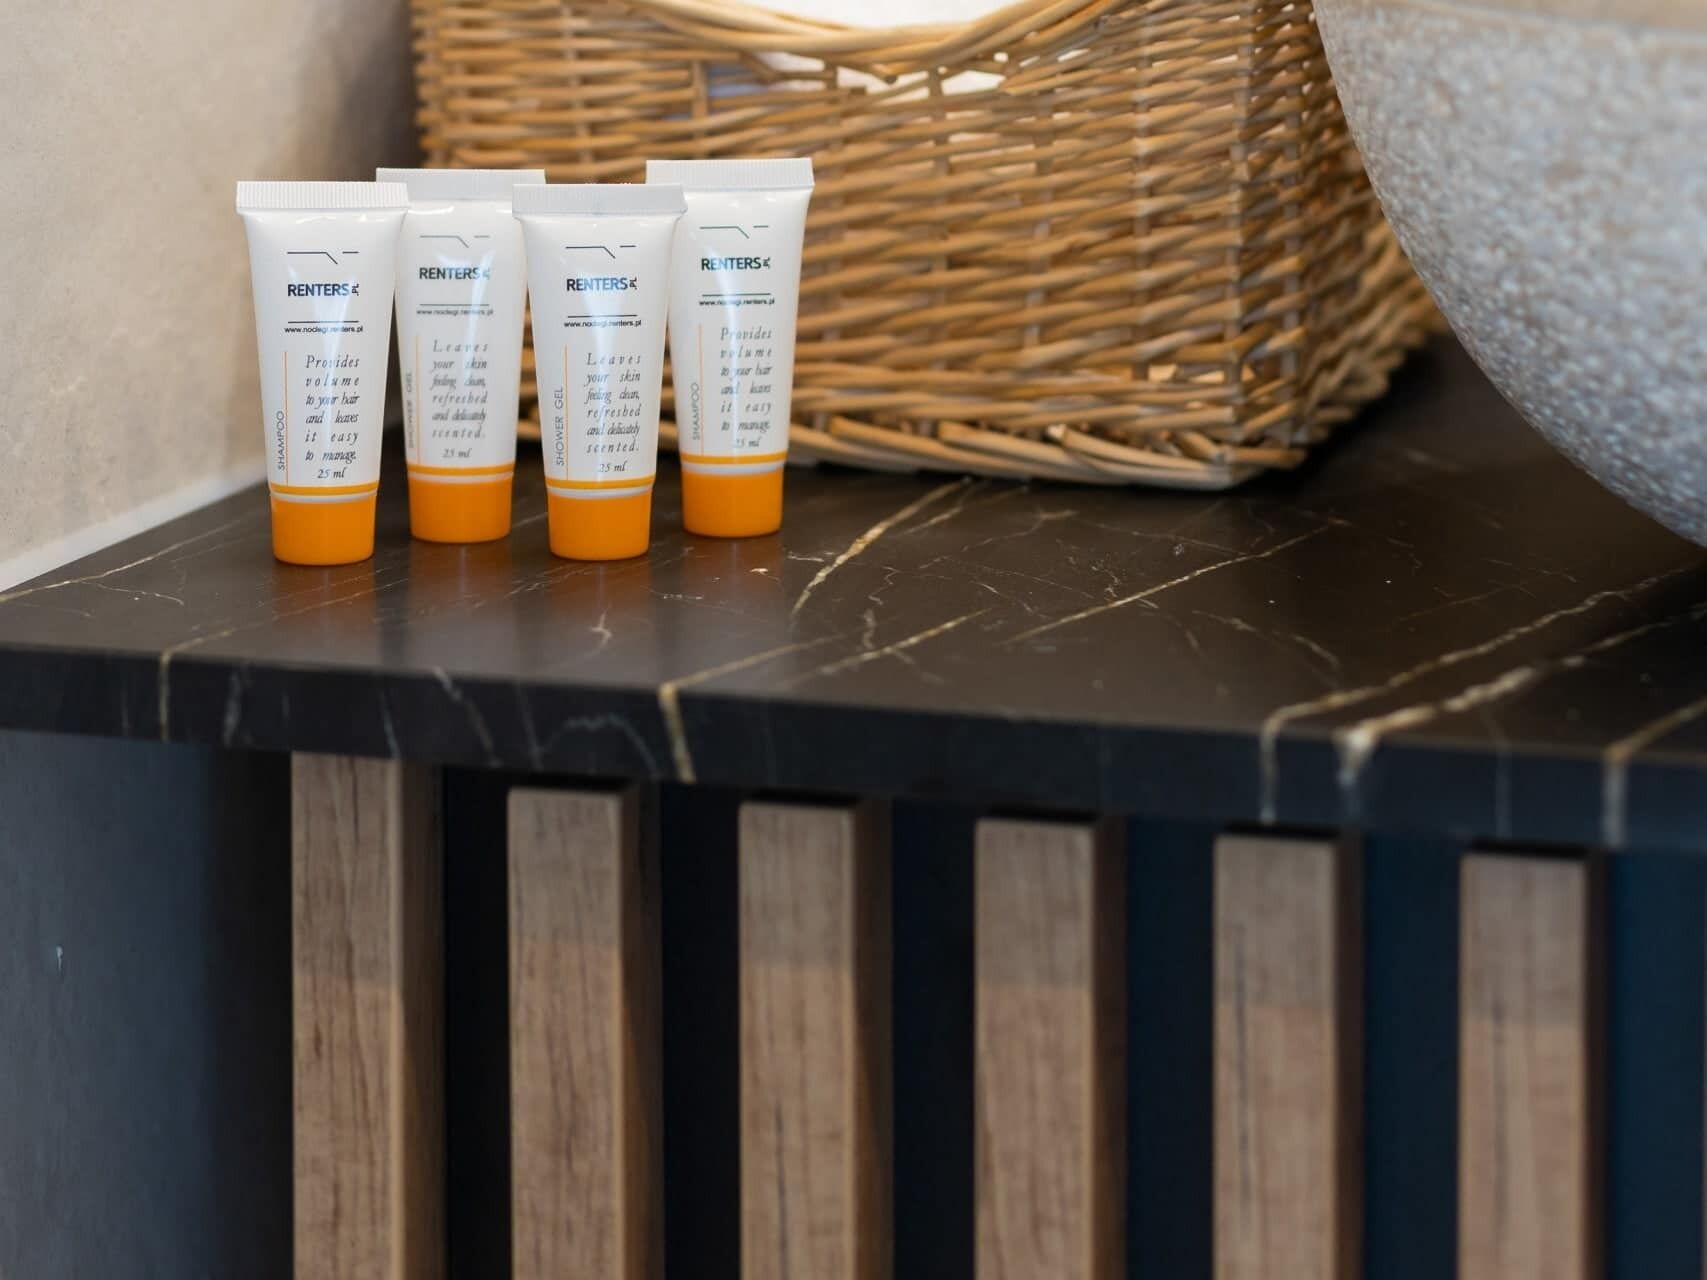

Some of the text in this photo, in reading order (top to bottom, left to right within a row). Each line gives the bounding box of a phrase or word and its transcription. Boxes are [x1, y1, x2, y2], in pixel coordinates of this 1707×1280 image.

[701, 257, 761, 271] RENTERS
[419, 267, 480, 280] RENTERS
[287, 283, 349, 297] RENTERS
[566, 277, 628, 291] RENTERS
[721, 326, 772, 341] Provides
[433, 339, 489, 353] Leaves
[305, 354, 360, 368] Provides
[587, 352, 641, 365] Leaves
[429, 360, 455, 375] your
[720, 366, 730, 376] to
[305, 372, 360, 387] volume
[584, 368, 640, 387] your skin
[305, 391, 360, 410] to your hair
[587, 403, 641, 422] refreshed
[721, 400, 771, 416] it easy
[305, 409, 359, 424] and leaves
[554, 386, 564, 466] SHOWER GEL
[587, 423, 605, 436] and
[721, 421, 730, 431] to
[276, 410, 285, 471] SHAMPOO
[305, 429, 359, 446] it easy
[748, 436, 761, 447] ml
[305, 450, 314, 461] to
[442, 448, 472, 458] 25 ml
[317, 466, 347, 479] 25 ml
[614, 460, 627, 472] ml
